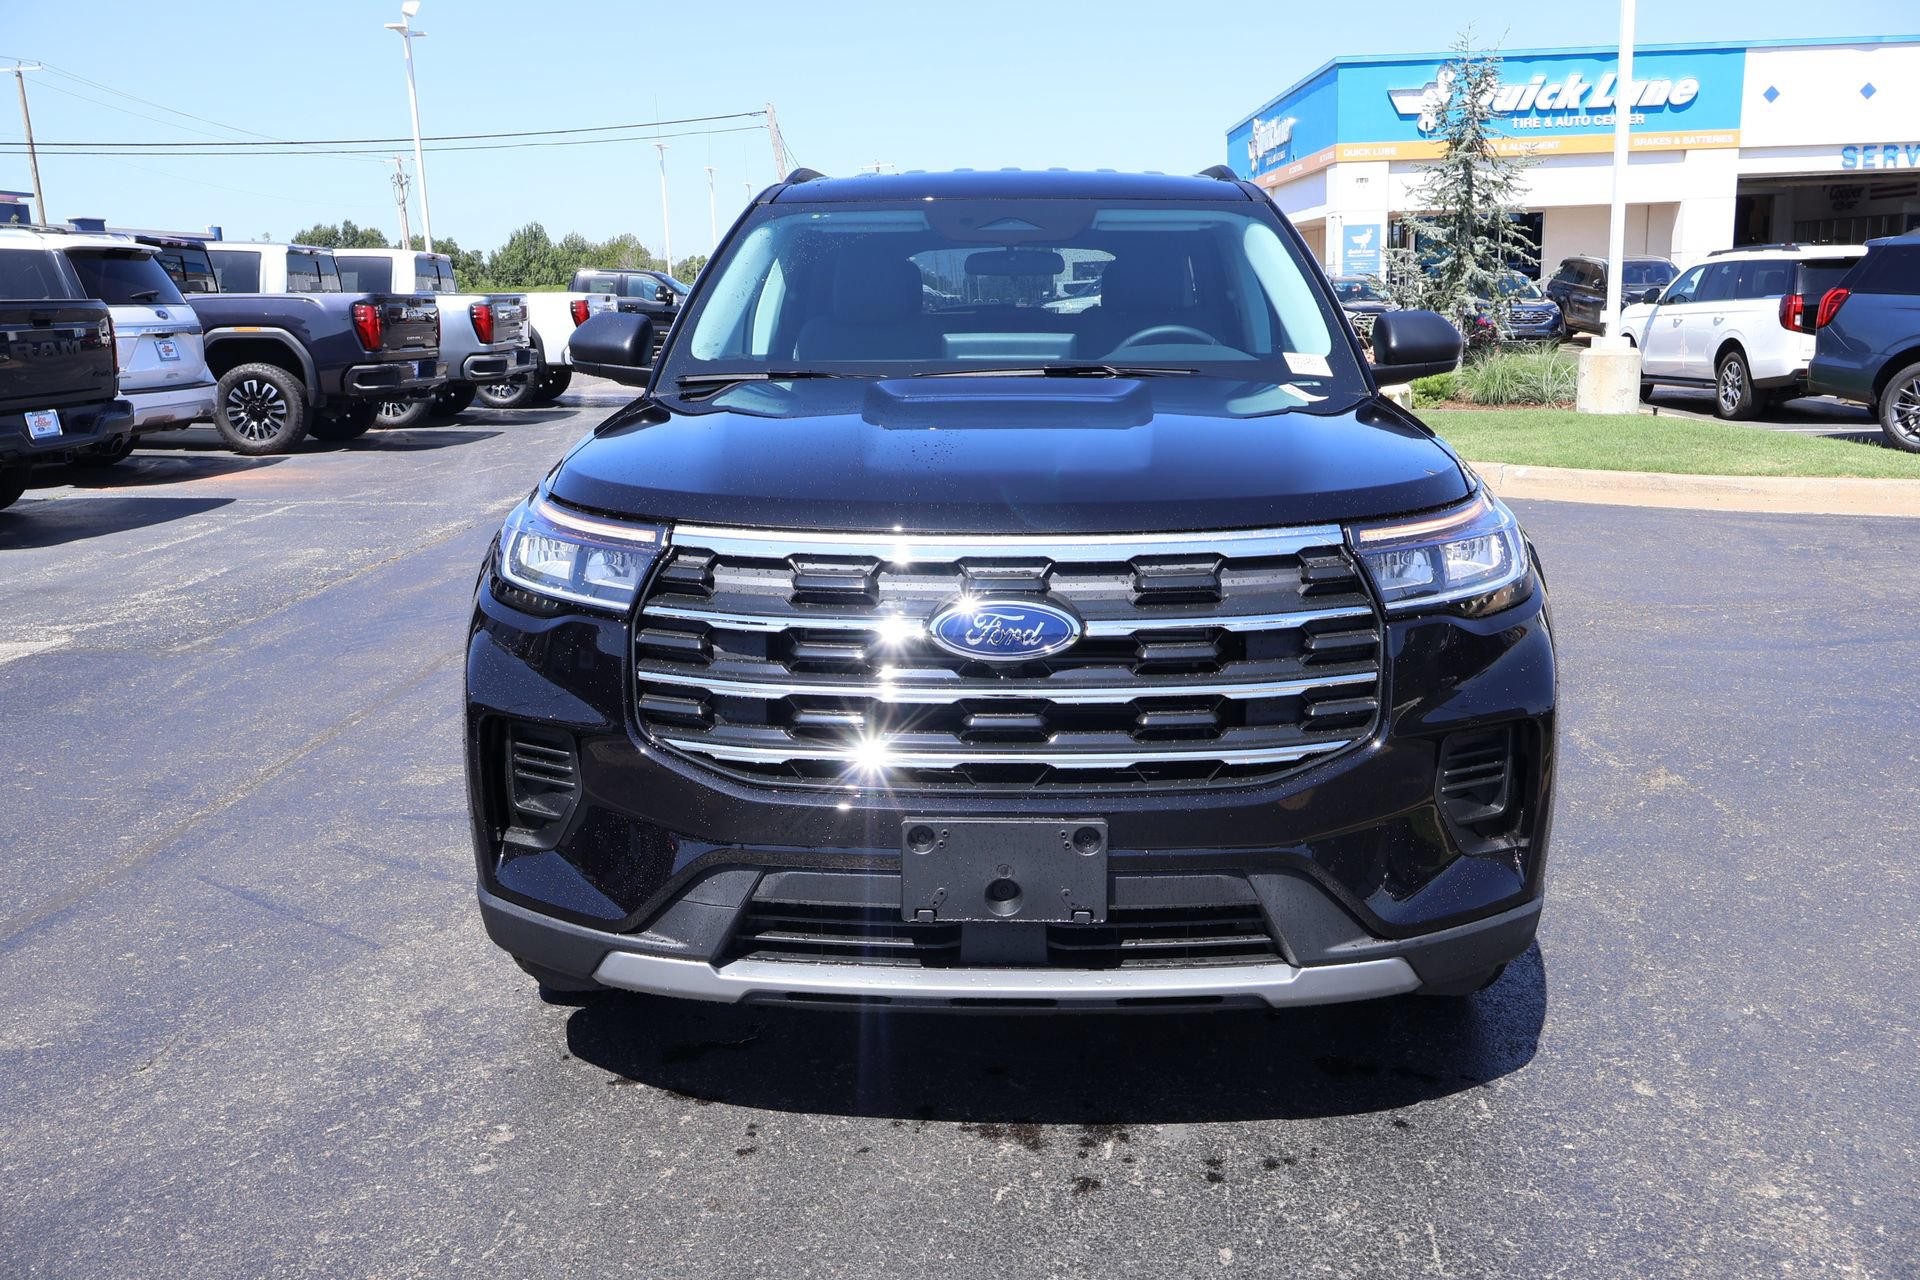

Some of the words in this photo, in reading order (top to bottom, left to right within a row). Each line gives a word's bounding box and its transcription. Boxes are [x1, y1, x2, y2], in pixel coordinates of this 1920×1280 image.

[1512, 117, 1541, 128] TIRE
[1544, 116, 1553, 127] &
[1555, 115, 1591, 126] AUTO
[1593, 114, 1645, 126] CENER
[1633, 137, 1673, 146] BRAKES
[1674, 137, 1680, 145] &
[1682, 135, 1735, 144] BATTERIES
[1344, 148, 1371, 157] QUICK
[1373, 147, 1398, 156] LUBE
[1841, 144, 1920, 170] SERV
[9, 339, 81, 359] RAM
[965, 612, 1046, 646] Ford
